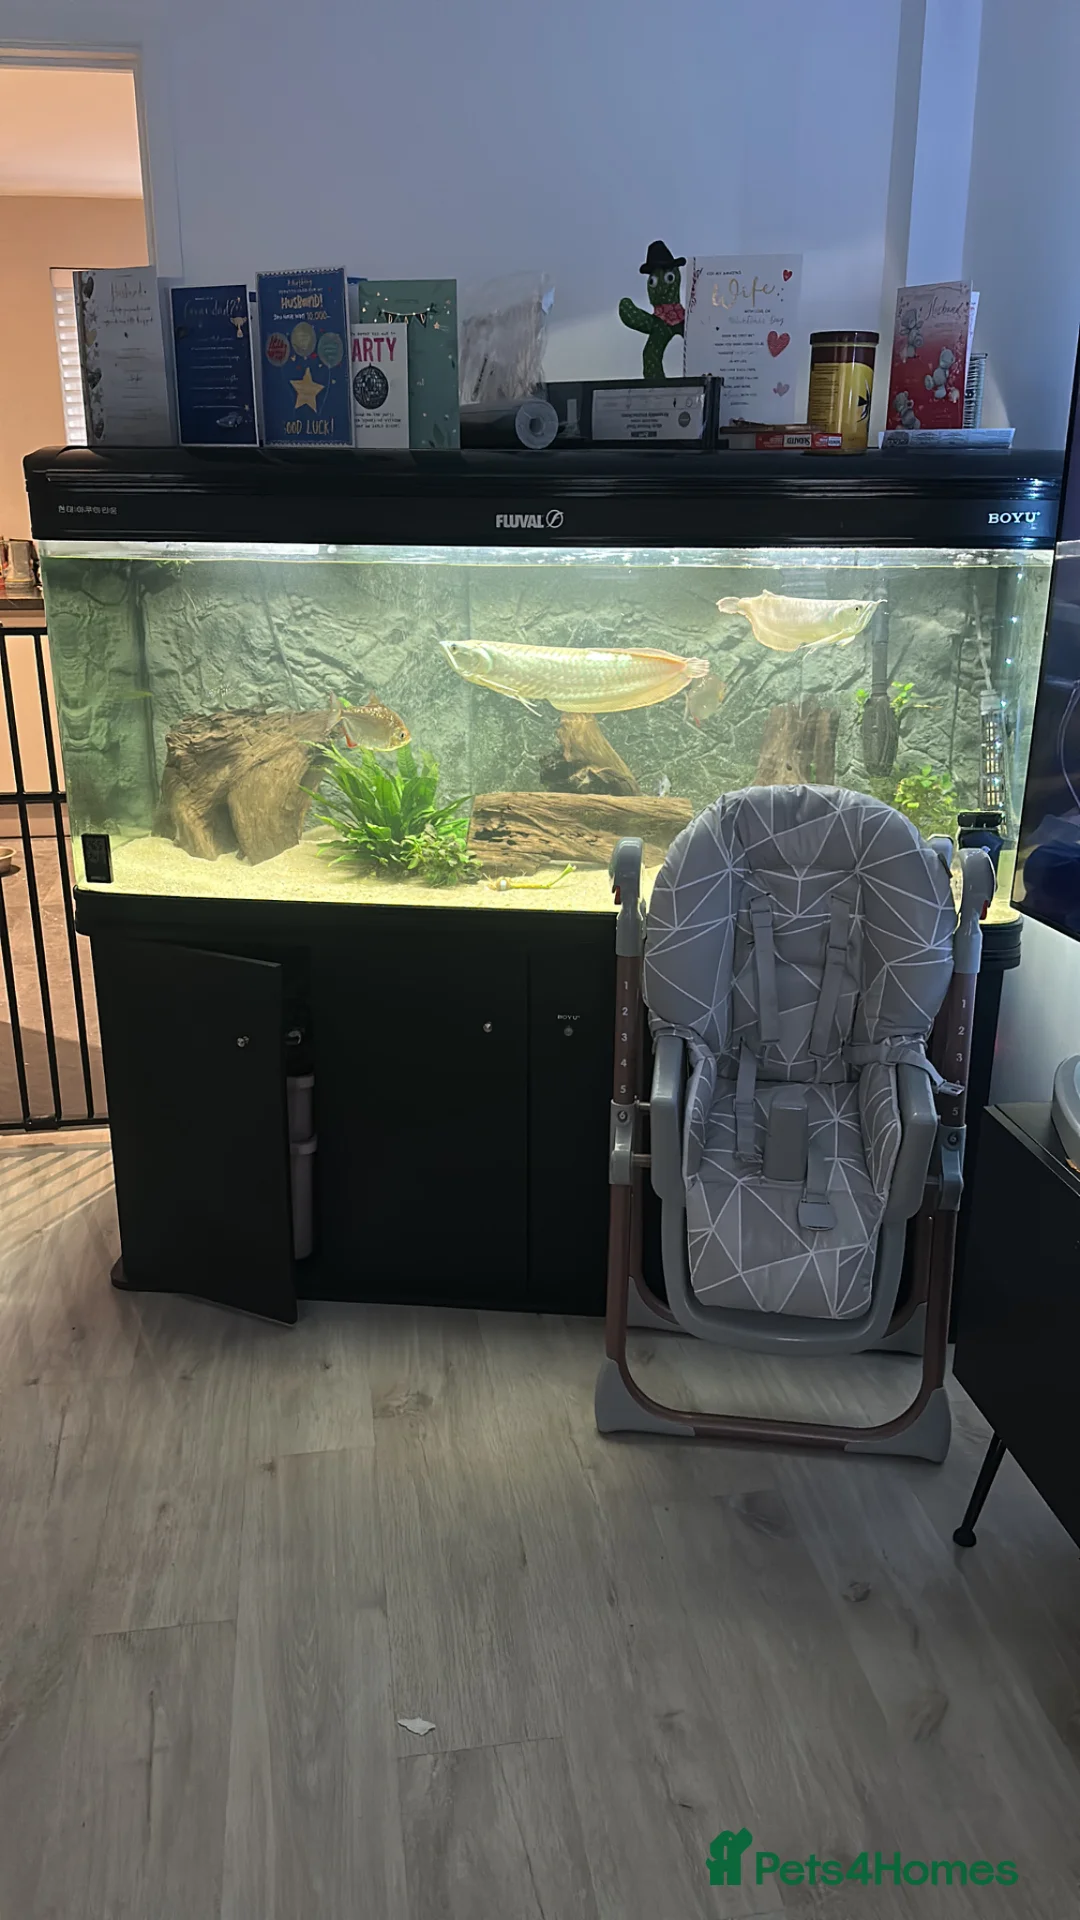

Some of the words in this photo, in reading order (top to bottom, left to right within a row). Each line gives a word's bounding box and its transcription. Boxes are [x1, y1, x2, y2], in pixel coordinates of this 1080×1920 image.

[712, 276, 776, 310] Wife
[496, 514, 544, 528] FLUVAL
[988, 511, 1037, 524] BOYU
[624, 981, 629, 990] 1
[961, 999, 966, 1008] 1
[622, 1007, 629, 1016] 2
[958, 1026, 965, 1035] 2
[621, 1033, 628, 1042] 3
[956, 1053, 963, 1062] 3
[620, 1059, 627, 1067] 4
[620, 1085, 627, 1094] 5
[619, 1111, 626, 1120] 6
[952, 1107, 959, 1116] 5
